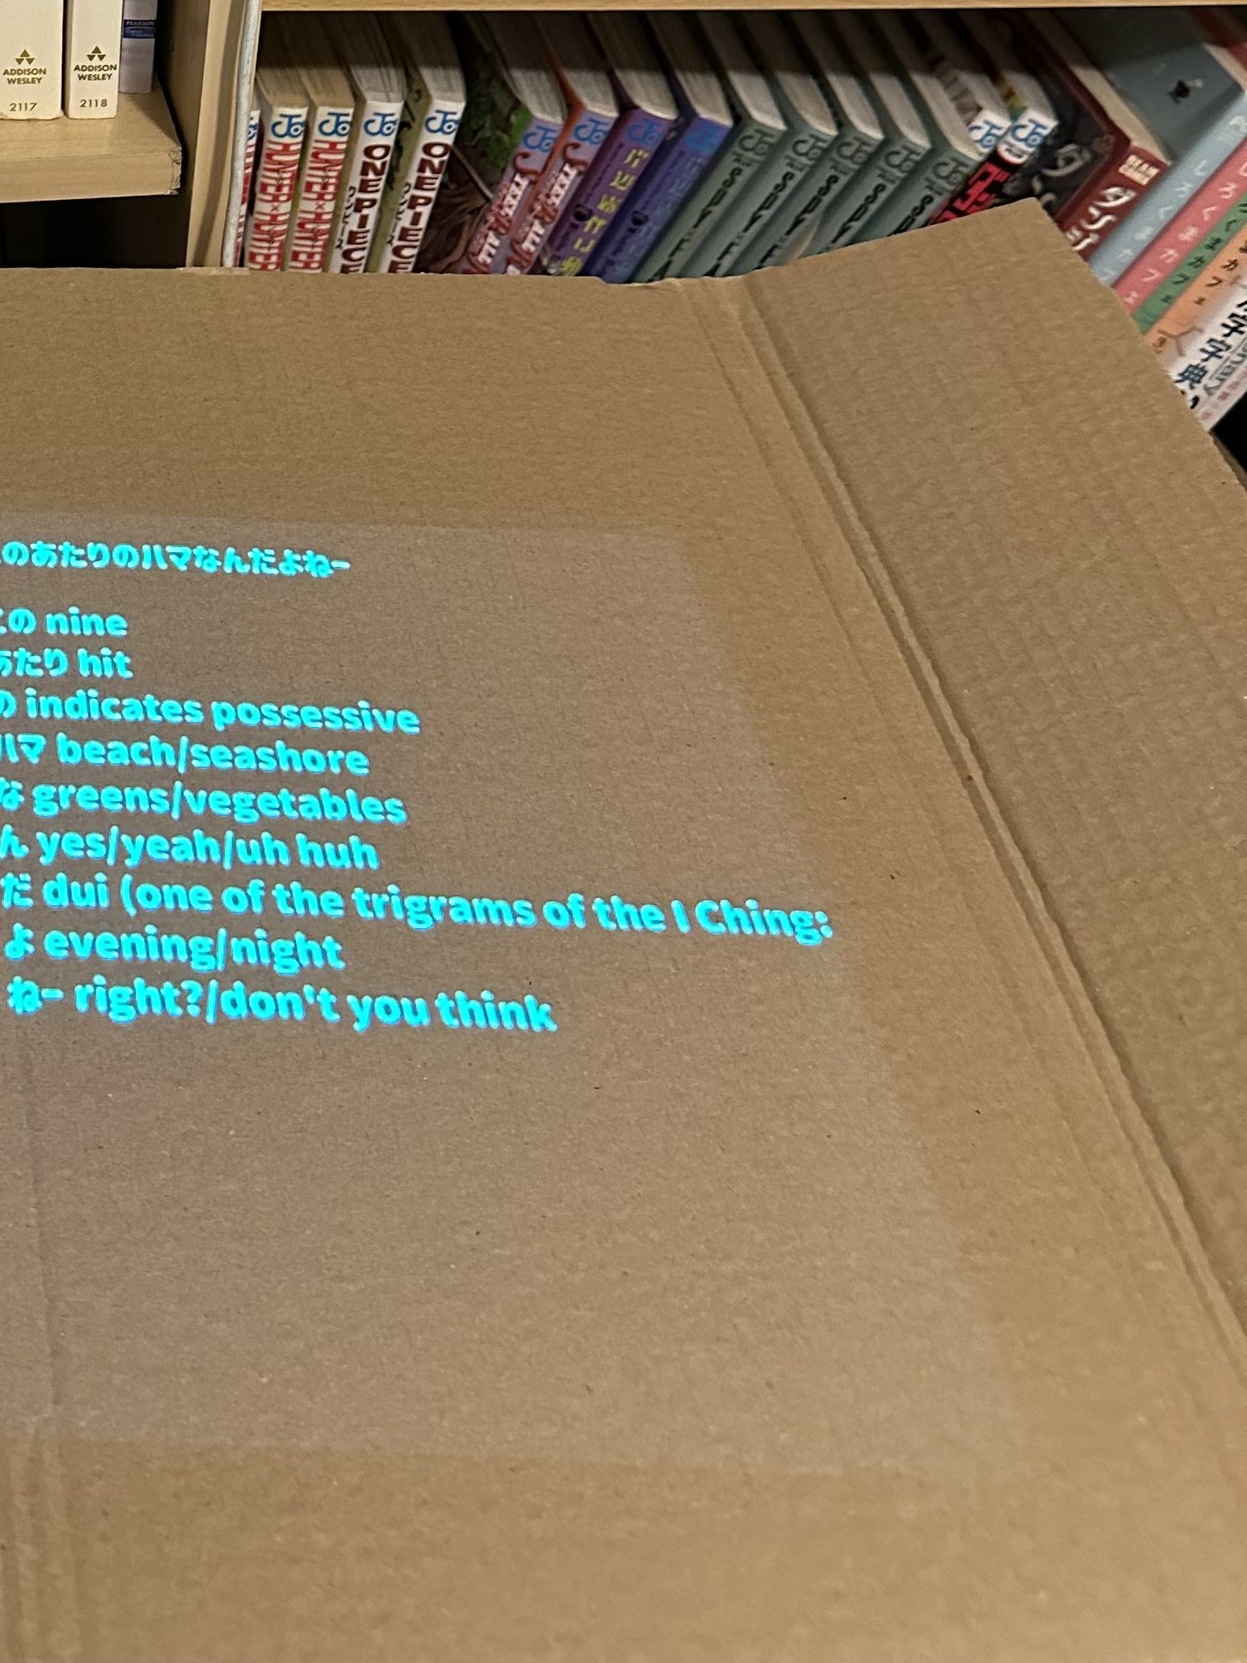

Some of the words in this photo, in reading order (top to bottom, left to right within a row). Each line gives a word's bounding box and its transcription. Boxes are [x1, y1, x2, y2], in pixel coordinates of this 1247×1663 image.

[9, 101, 38, 113] 2117
[80, 98, 108, 109] 2118
[46, 606, 128, 636] nine
[78, 647, 133, 678] hit
[25, 688, 203, 723] indicates
[212, 700, 420, 733] possessive
[56, 732, 370, 775] beach/seashore
[32, 780, 407, 824] greens/vegetables
[36, 825, 290, 869] yes/yeah/uh
[295, 833, 380, 869] huh
[0, 872, 34, 908] だ
[42, 872, 110, 909] dui
[120, 874, 213, 915] (one
[221, 879, 264, 914] of
[272, 882, 344, 917] the
[351, 884, 537, 930] trigrams
[542, 893, 587, 929] of
[591, 894, 666, 932] the
[671, 899, 690, 933] I
[4, 923, 34, 960] よ
[44, 924, 345, 974] evening/night
[7, 976, 64, 1014] ねー
[74, 975, 340, 1024] right?/don't
[347, 992, 430, 1032] you
[435, 990, 557, 1032] think
